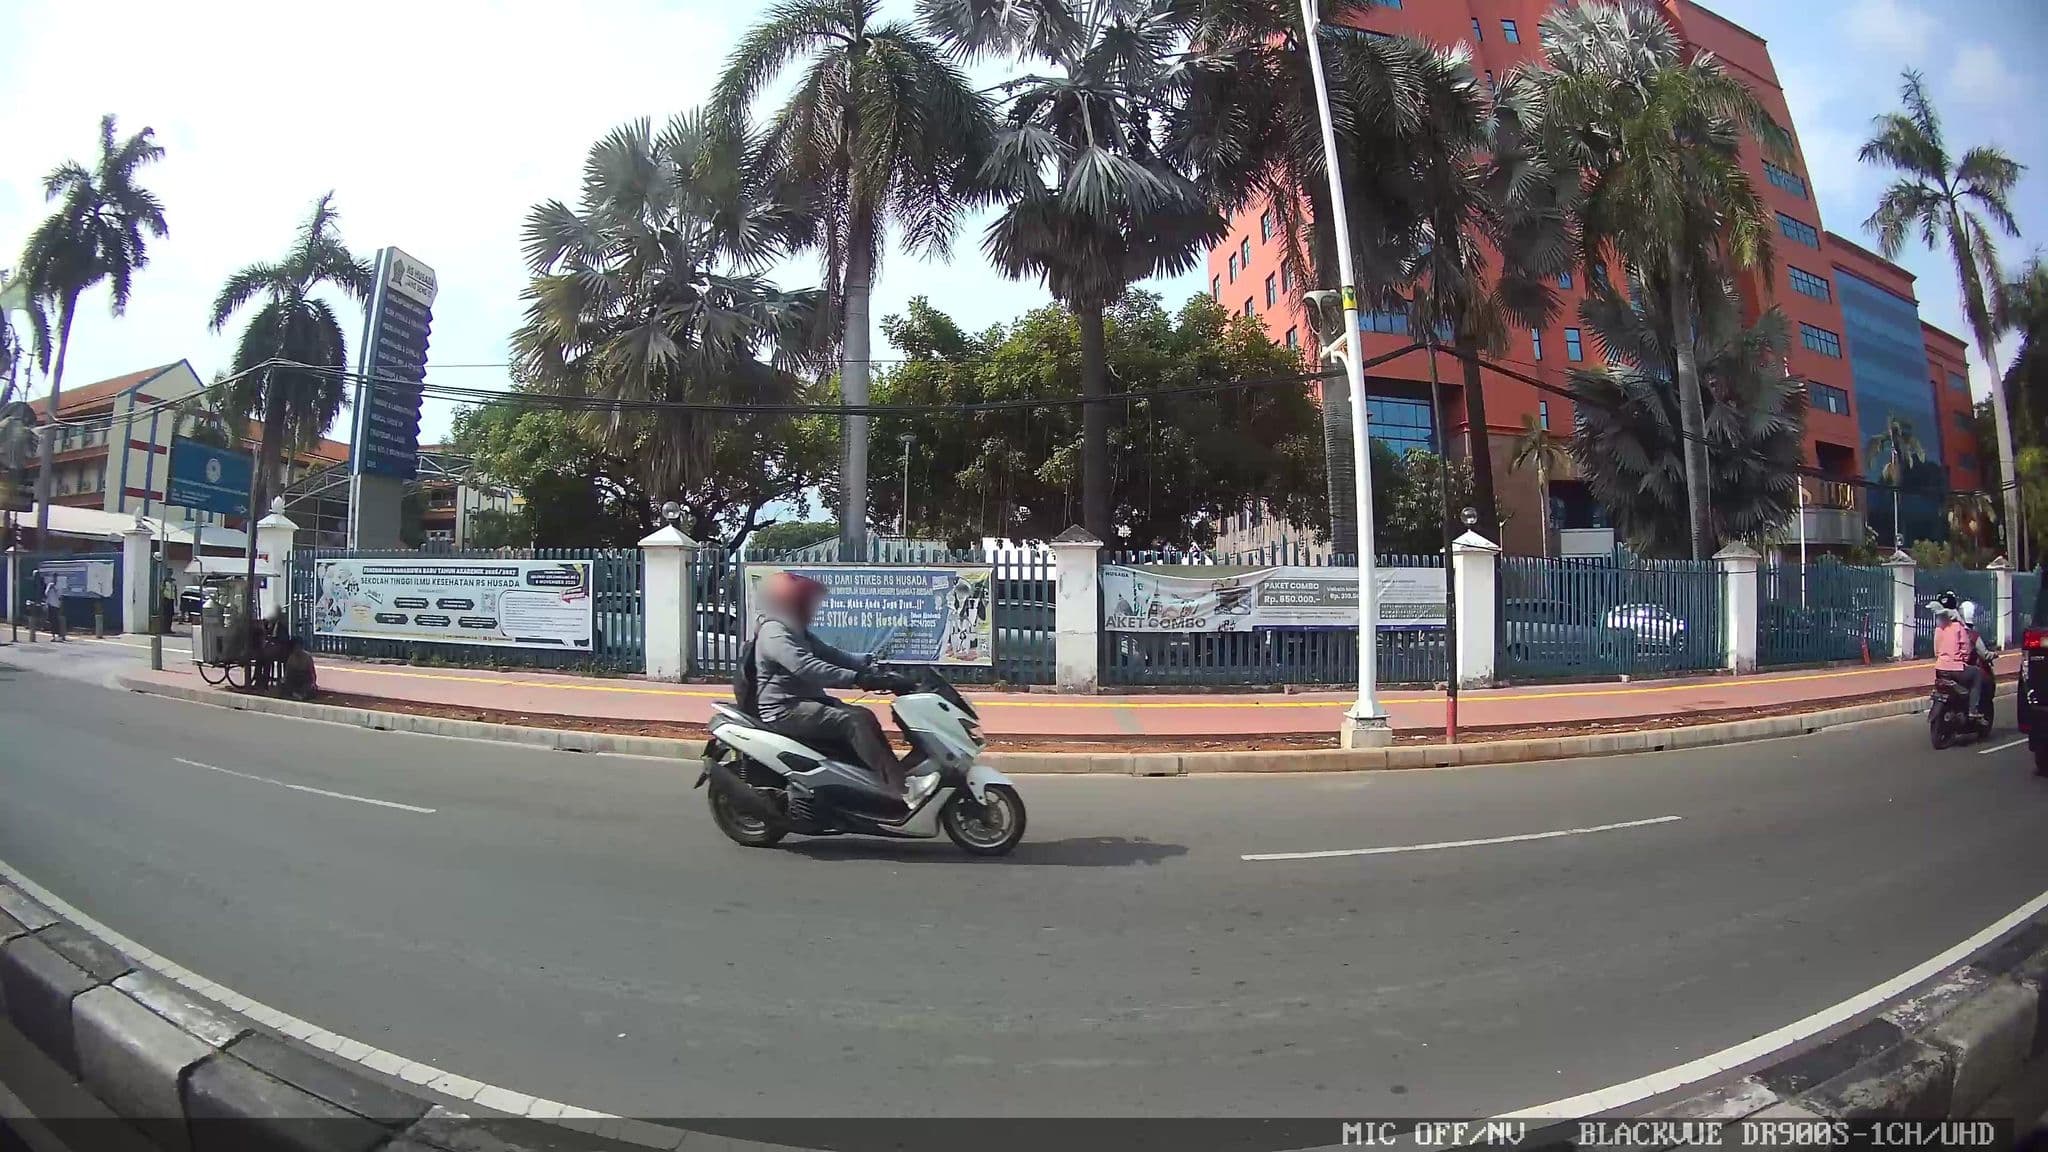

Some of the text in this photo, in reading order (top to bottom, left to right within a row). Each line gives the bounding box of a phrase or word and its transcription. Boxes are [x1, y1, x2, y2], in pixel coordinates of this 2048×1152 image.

[361, 577, 389, 585] SEKOLAH
[390, 577, 413, 585] TINGGI
[414, 577, 431, 586] ILMU
[432, 578, 475, 586] KESEHATAN
[487, 579, 520, 588] HUSADA
[834, 574, 853, 585] DARI
[854, 574, 882, 586] STIKES
[883, 575, 894, 585] RS
[896, 575, 928, 586] HUSADA
[1264, 582, 1320, 591] PAKET COMBO
[1264, 595, 1279, 605] Rp.
[1105, 615, 1206, 629] AKET COMBO
